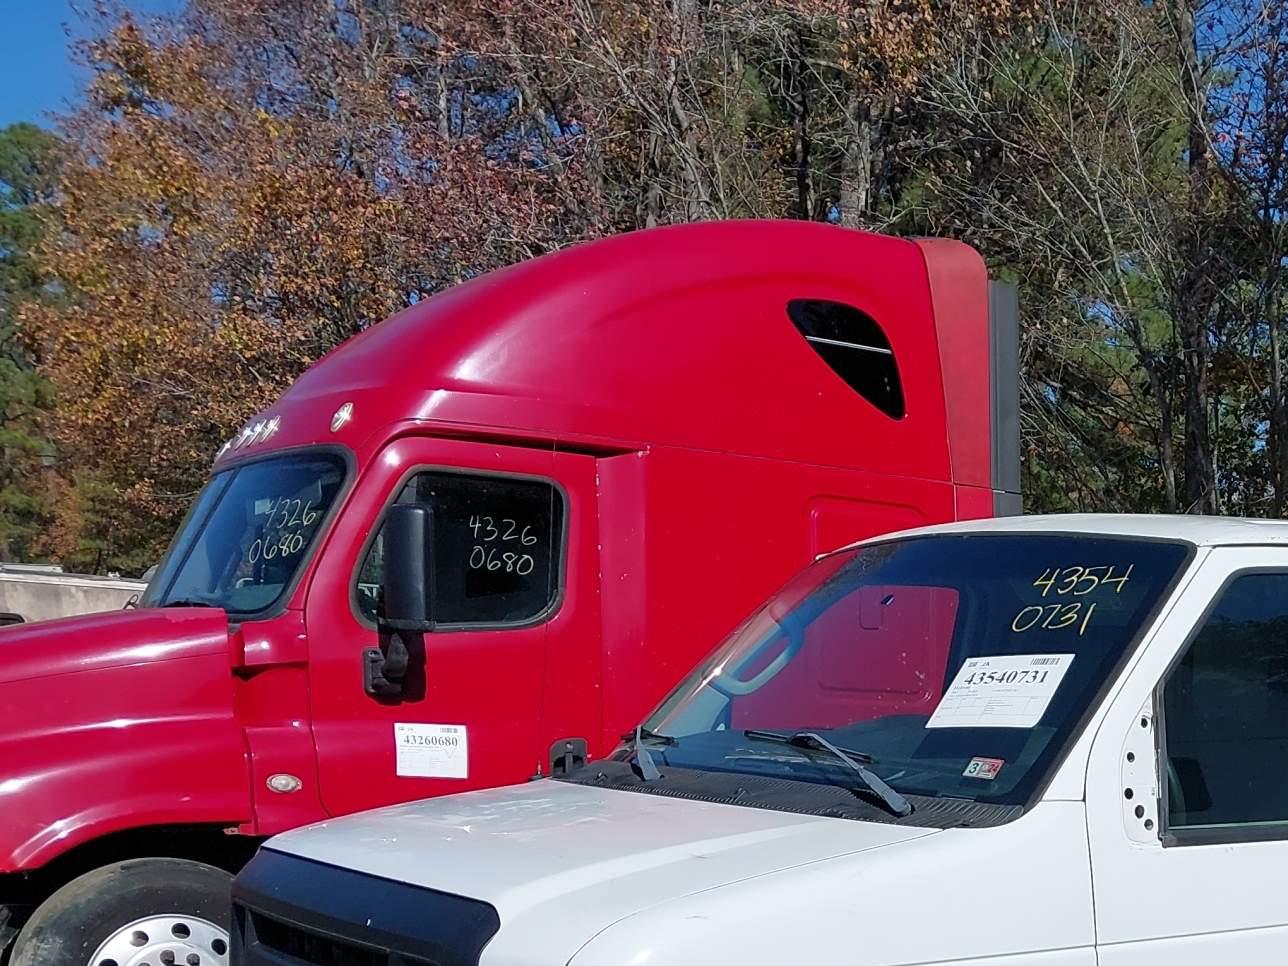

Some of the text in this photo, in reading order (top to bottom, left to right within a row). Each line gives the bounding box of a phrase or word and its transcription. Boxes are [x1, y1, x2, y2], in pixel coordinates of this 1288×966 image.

[265, 497, 317, 529] 4326
[469, 514, 537, 546] 4326
[248, 530, 304, 564] 0680
[469, 545, 535, 576] 0680
[1033, 564, 1134, 597] 4354
[1011, 602, 1097, 636] 0731
[963, 670, 1050, 686] 43540731
[403, 735, 458, 747] 43260680
[968, 762, 980, 774] 3
